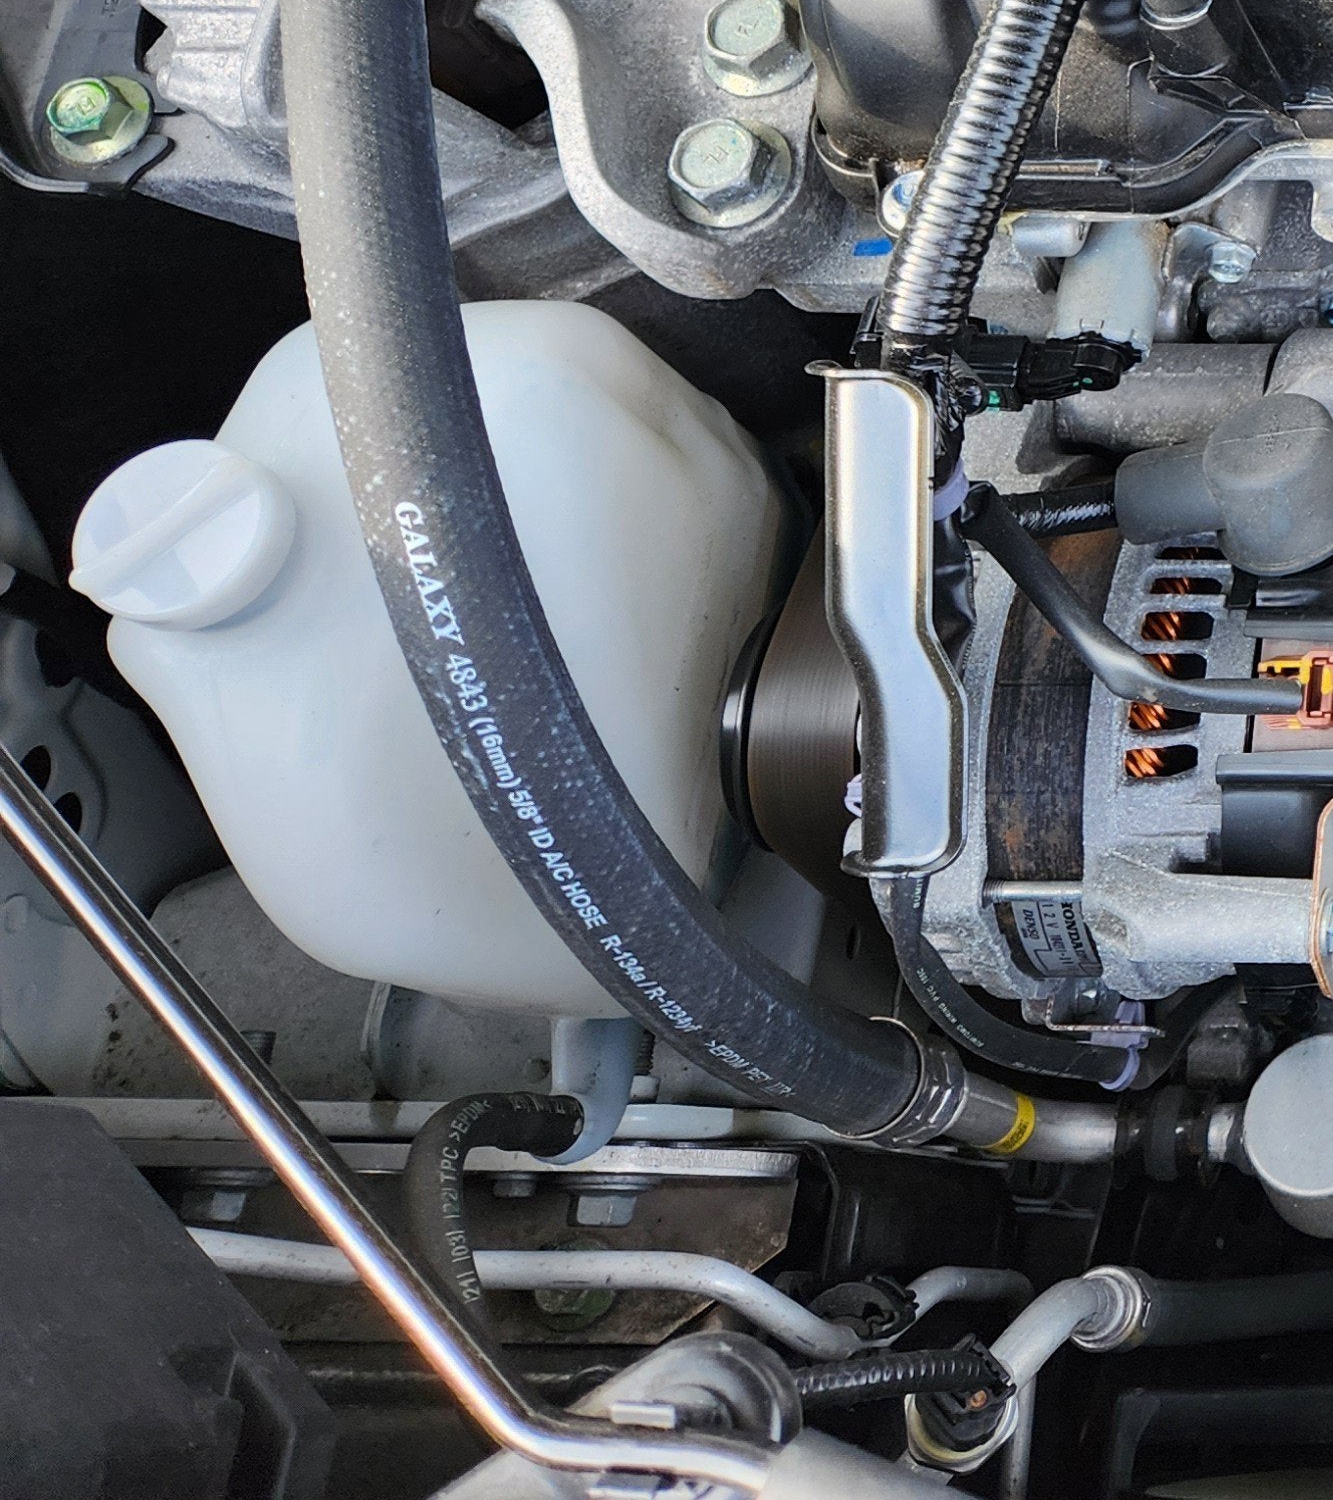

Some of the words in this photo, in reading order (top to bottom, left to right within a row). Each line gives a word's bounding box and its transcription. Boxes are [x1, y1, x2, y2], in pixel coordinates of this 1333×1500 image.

[394, 501, 466, 646] GALAXY
[444, 653, 489, 713] 4843
[468, 716, 522, 789] (16mm)
[528, 826, 556, 850] ID
[540, 849, 575, 882] A/C
[560, 878, 609, 931] HOSE
